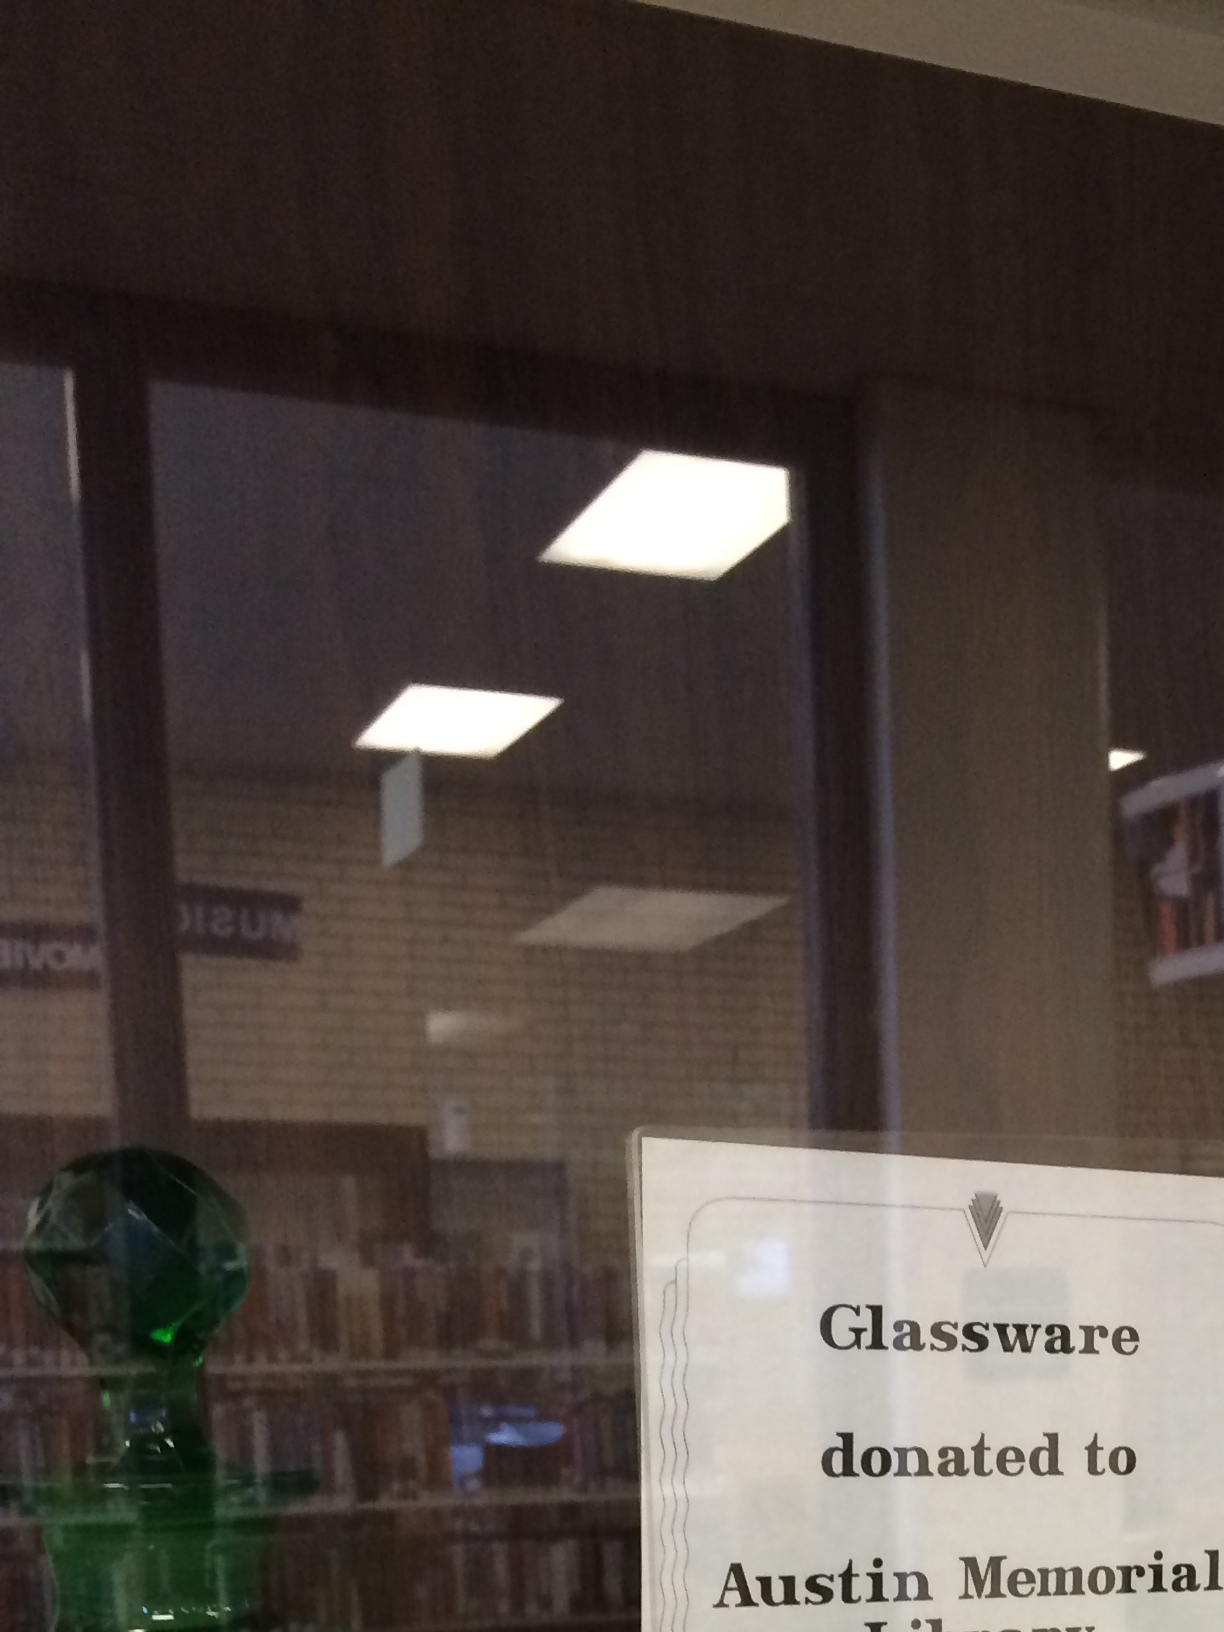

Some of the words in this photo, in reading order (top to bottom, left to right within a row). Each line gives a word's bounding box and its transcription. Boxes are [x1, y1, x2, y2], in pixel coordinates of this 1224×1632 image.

[820, 1303, 1140, 1356] Glassware
[821, 1432, 1065, 1478] donated
[1085, 1432, 1137, 1476] to
[713, 1557, 934, 1609] Austin
[959, 1549, 1224, 1600] Memorial
